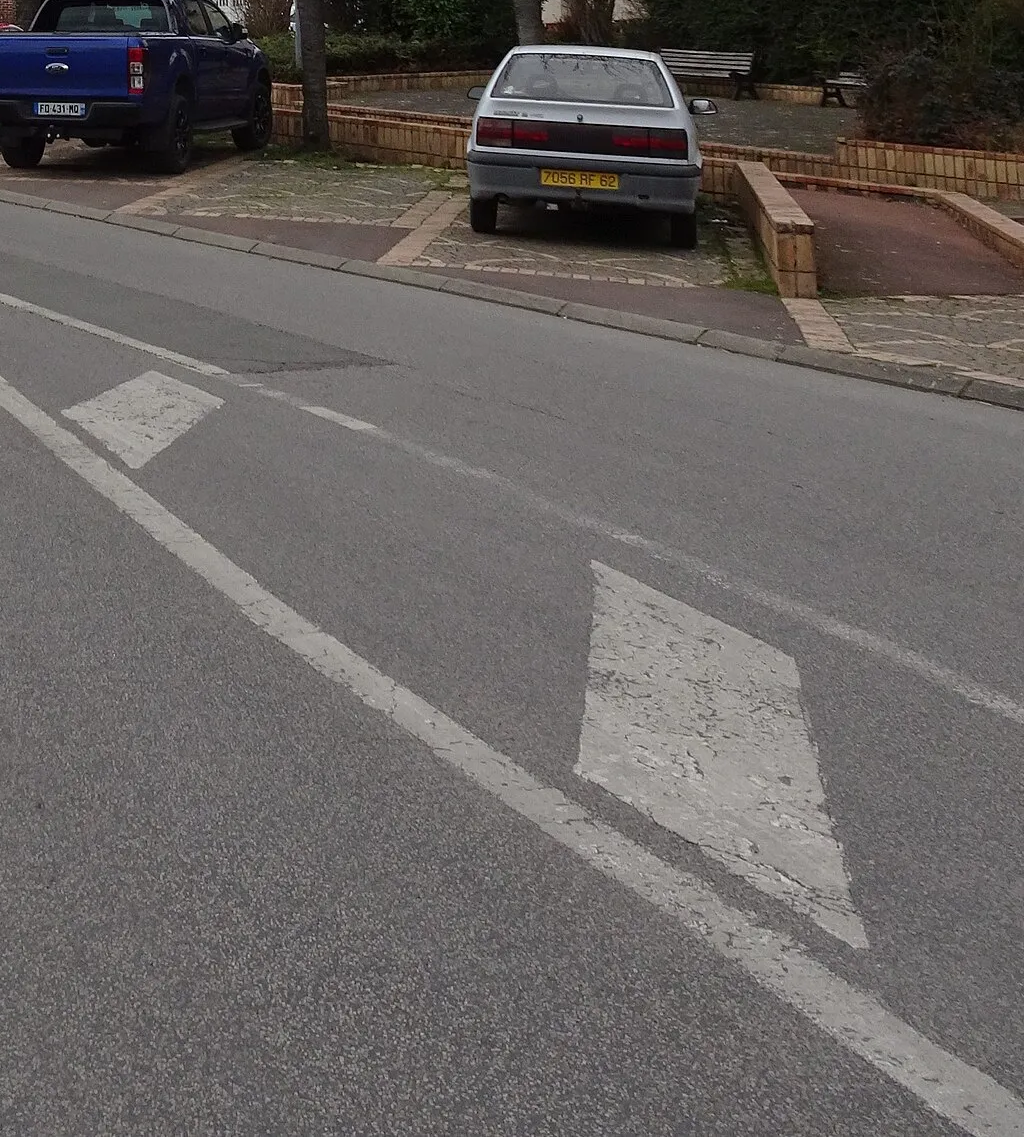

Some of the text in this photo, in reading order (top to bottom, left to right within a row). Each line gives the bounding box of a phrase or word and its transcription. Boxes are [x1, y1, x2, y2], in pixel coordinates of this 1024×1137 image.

[543, 171, 616, 188] 7056 RF 62
